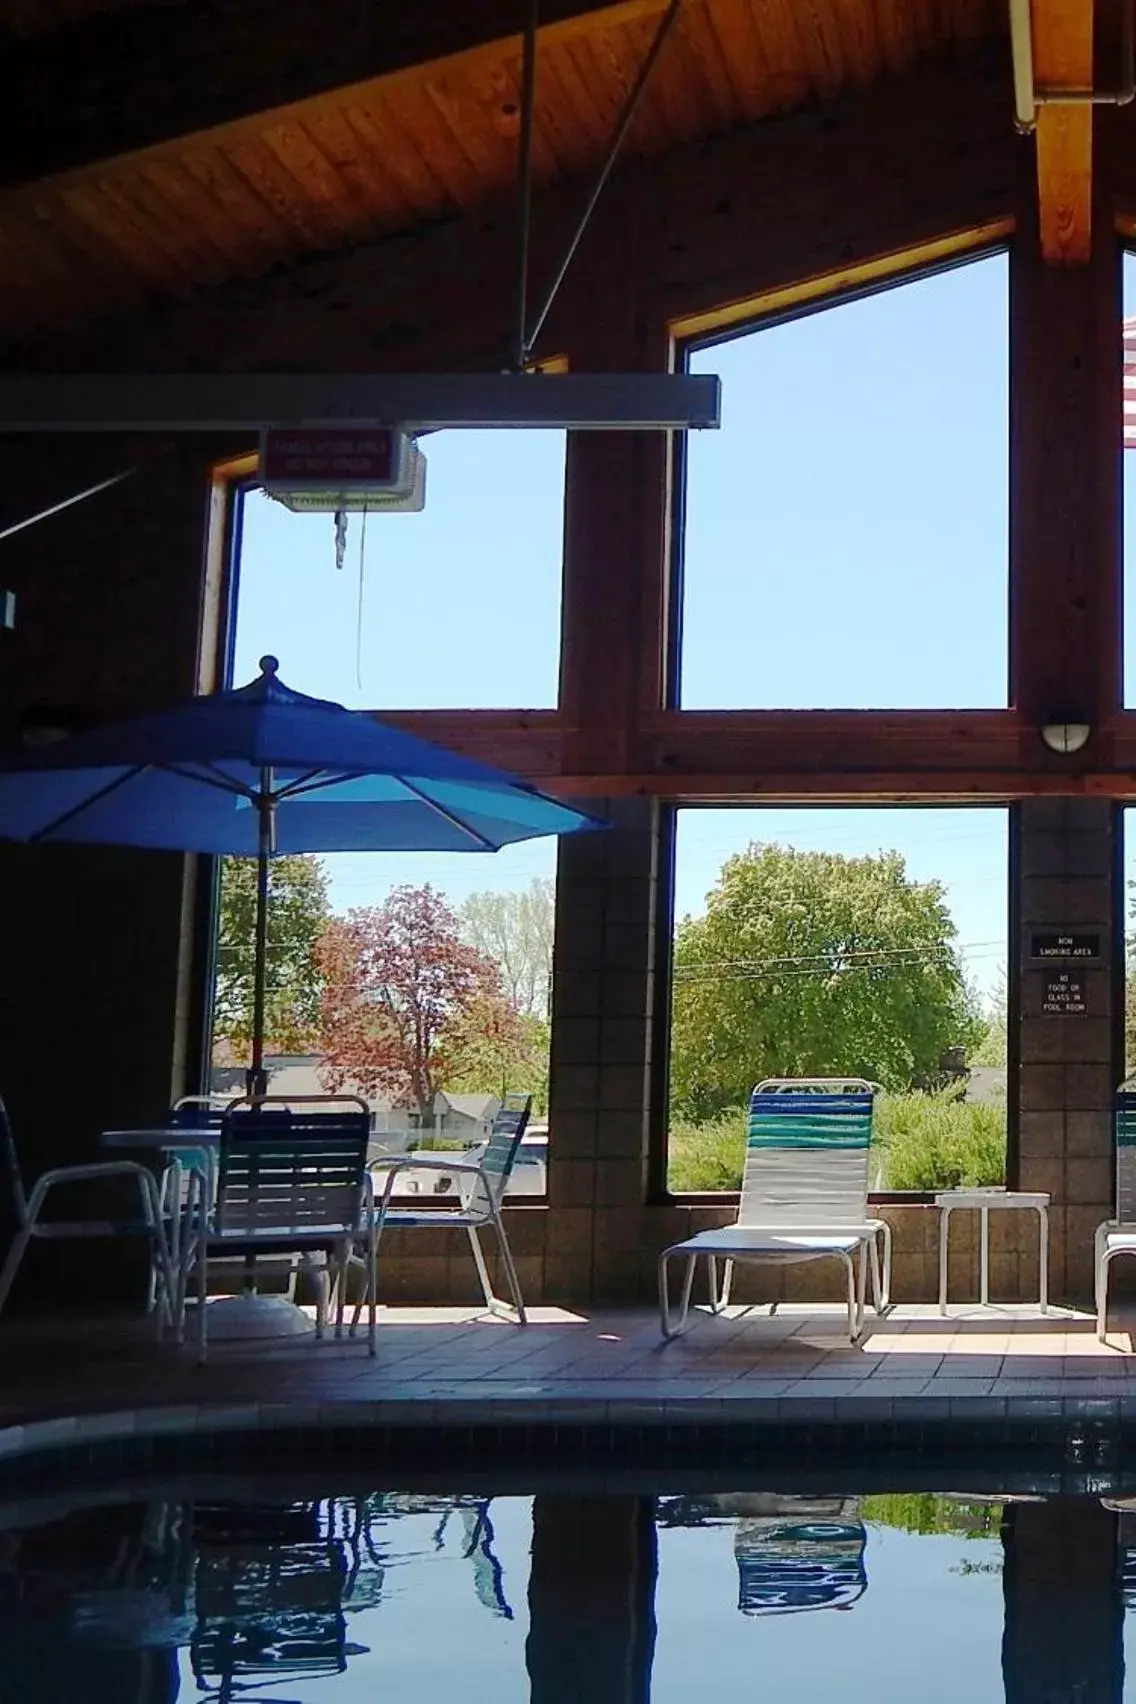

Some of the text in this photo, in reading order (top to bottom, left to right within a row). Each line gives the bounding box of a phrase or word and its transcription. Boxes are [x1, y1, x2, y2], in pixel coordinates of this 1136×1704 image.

[1040, 947, 1092, 956] SMOKING AREA
[1060, 975, 1069, 983] NO
[1048, 984, 1079, 992] FOOD OR
[1043, 1003, 1085, 1012] POOL ROOM
